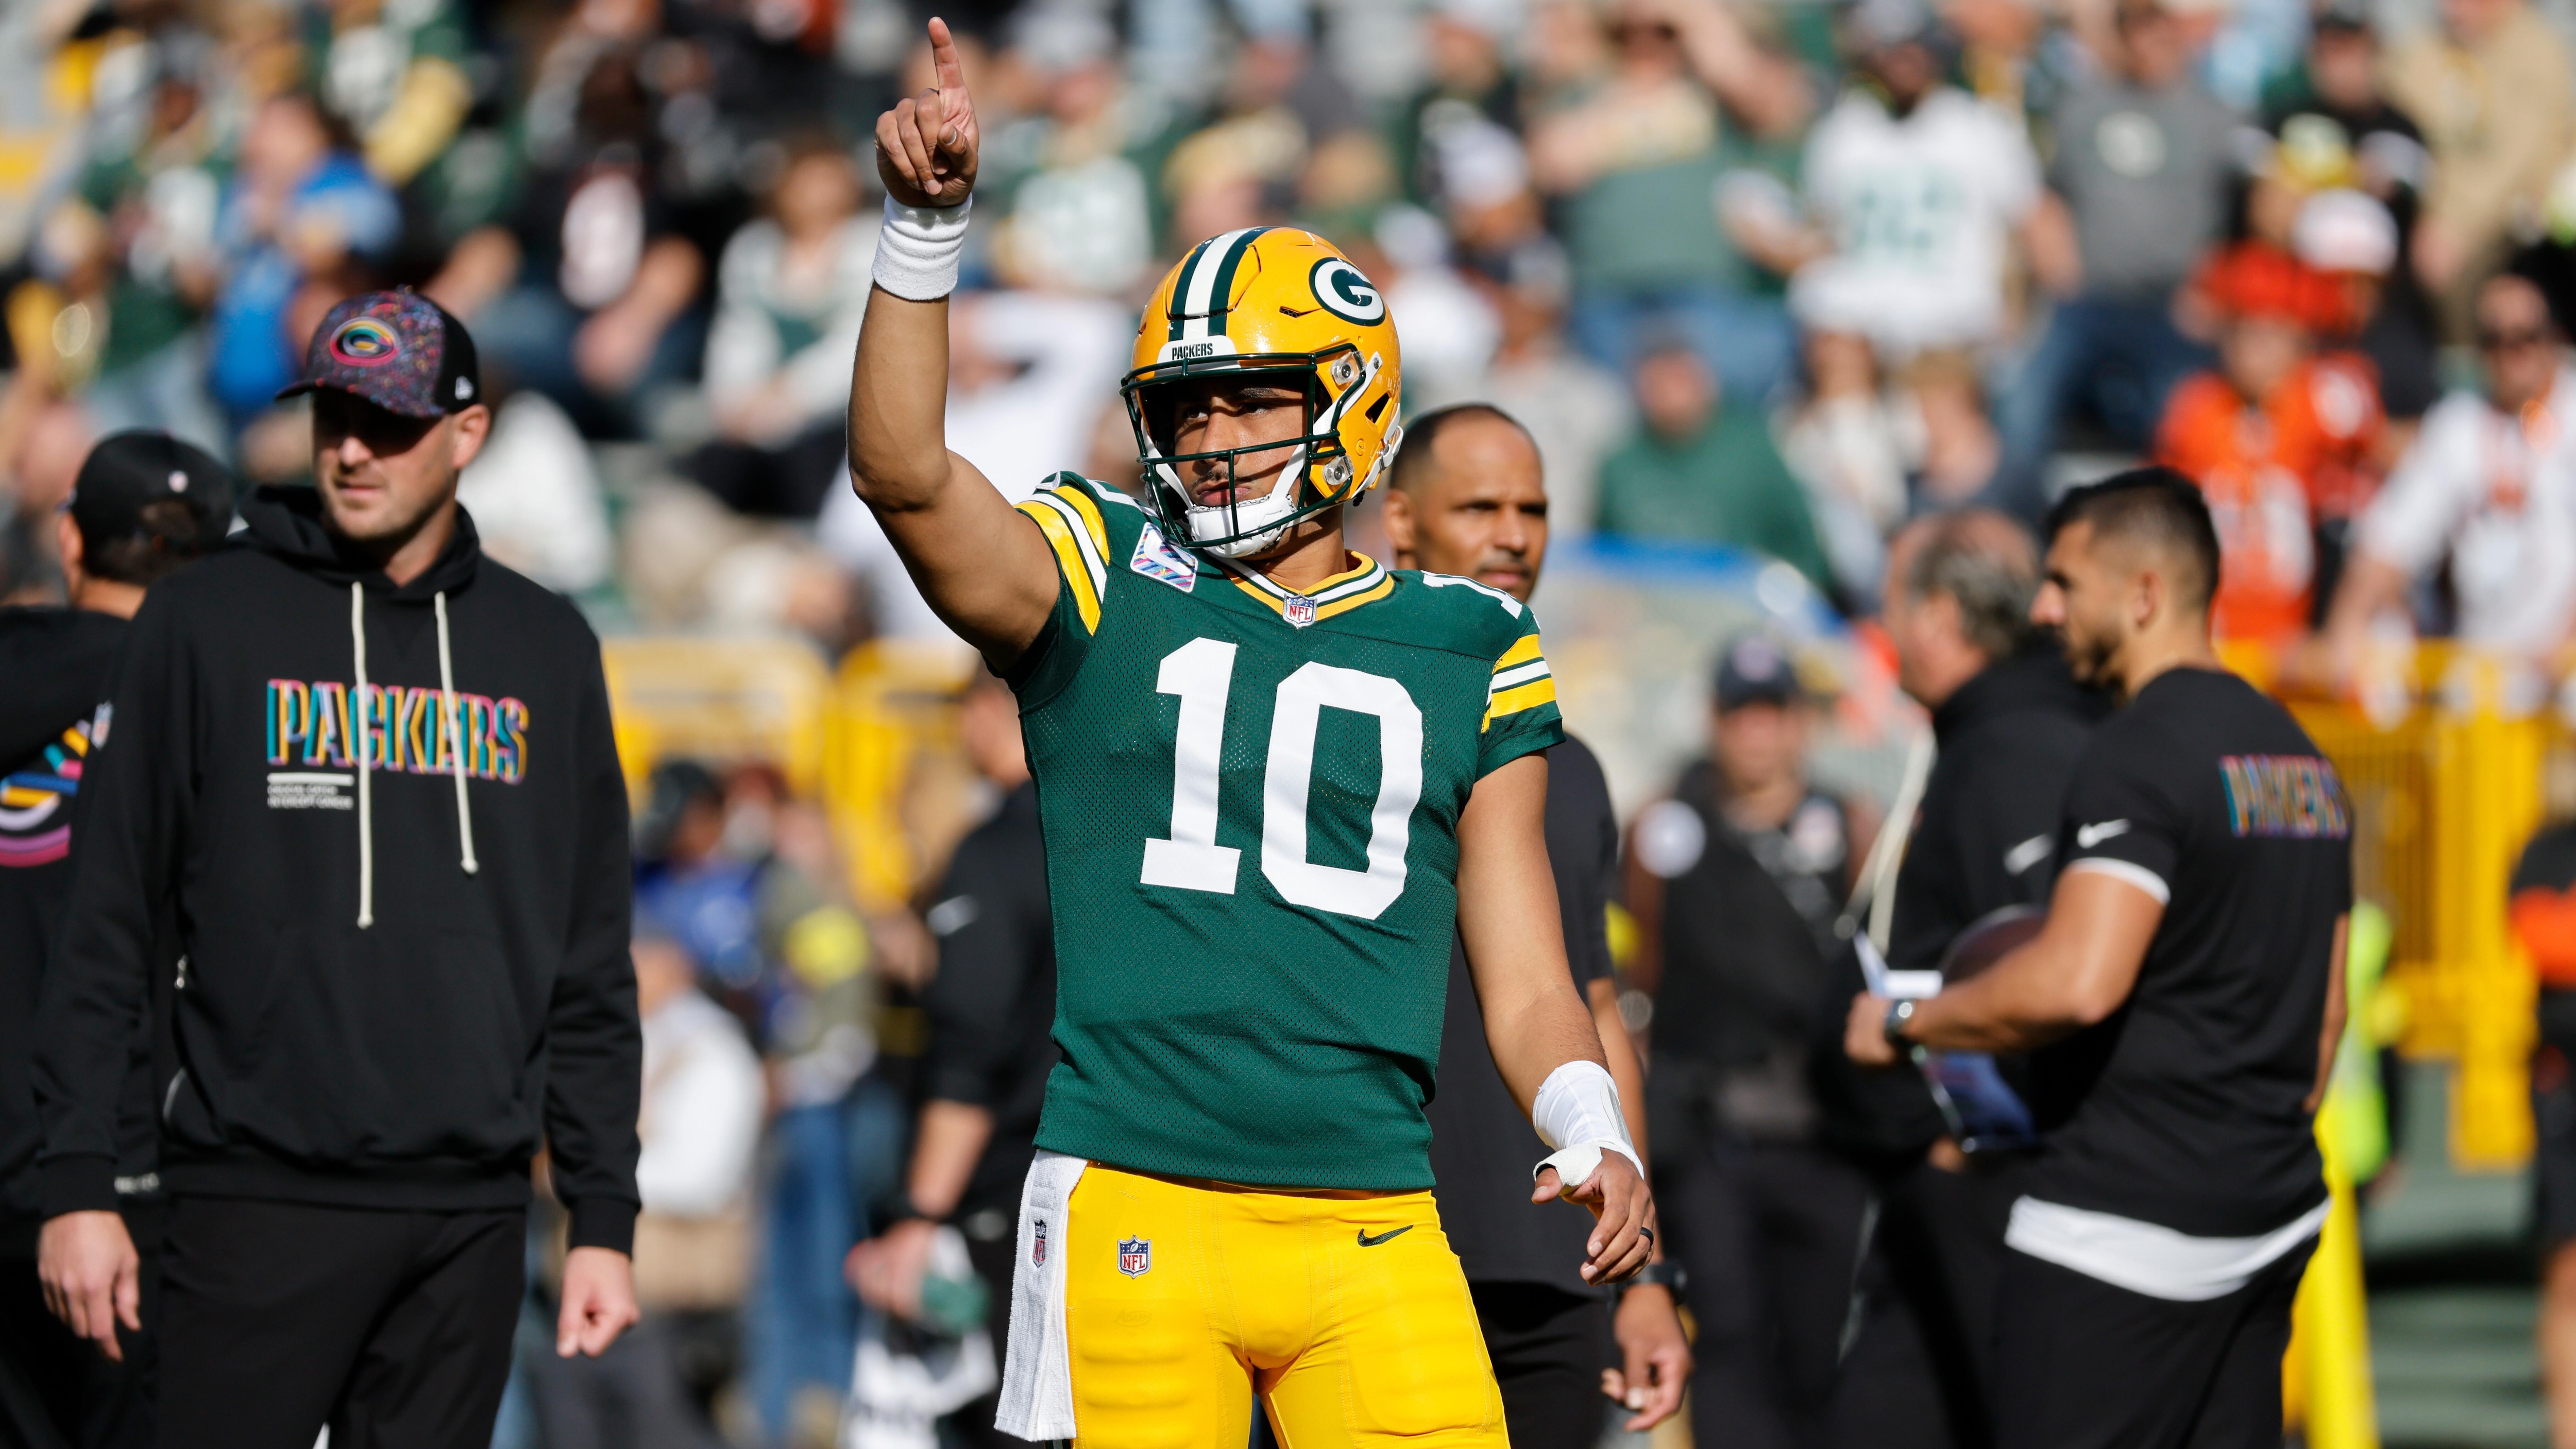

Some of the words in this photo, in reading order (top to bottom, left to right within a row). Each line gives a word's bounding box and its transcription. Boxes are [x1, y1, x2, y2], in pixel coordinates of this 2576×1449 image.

[1314, 260, 1384, 320] G
[1172, 343, 1213, 361] PACKERS
[1289, 605, 1311, 621] NFL
[267, 678, 530, 785] PACKERS
[1140, 637, 1423, 920] 10
[1033, 1239, 1045, 1263] NFL
[1122, 1255, 1146, 1271] NFL
